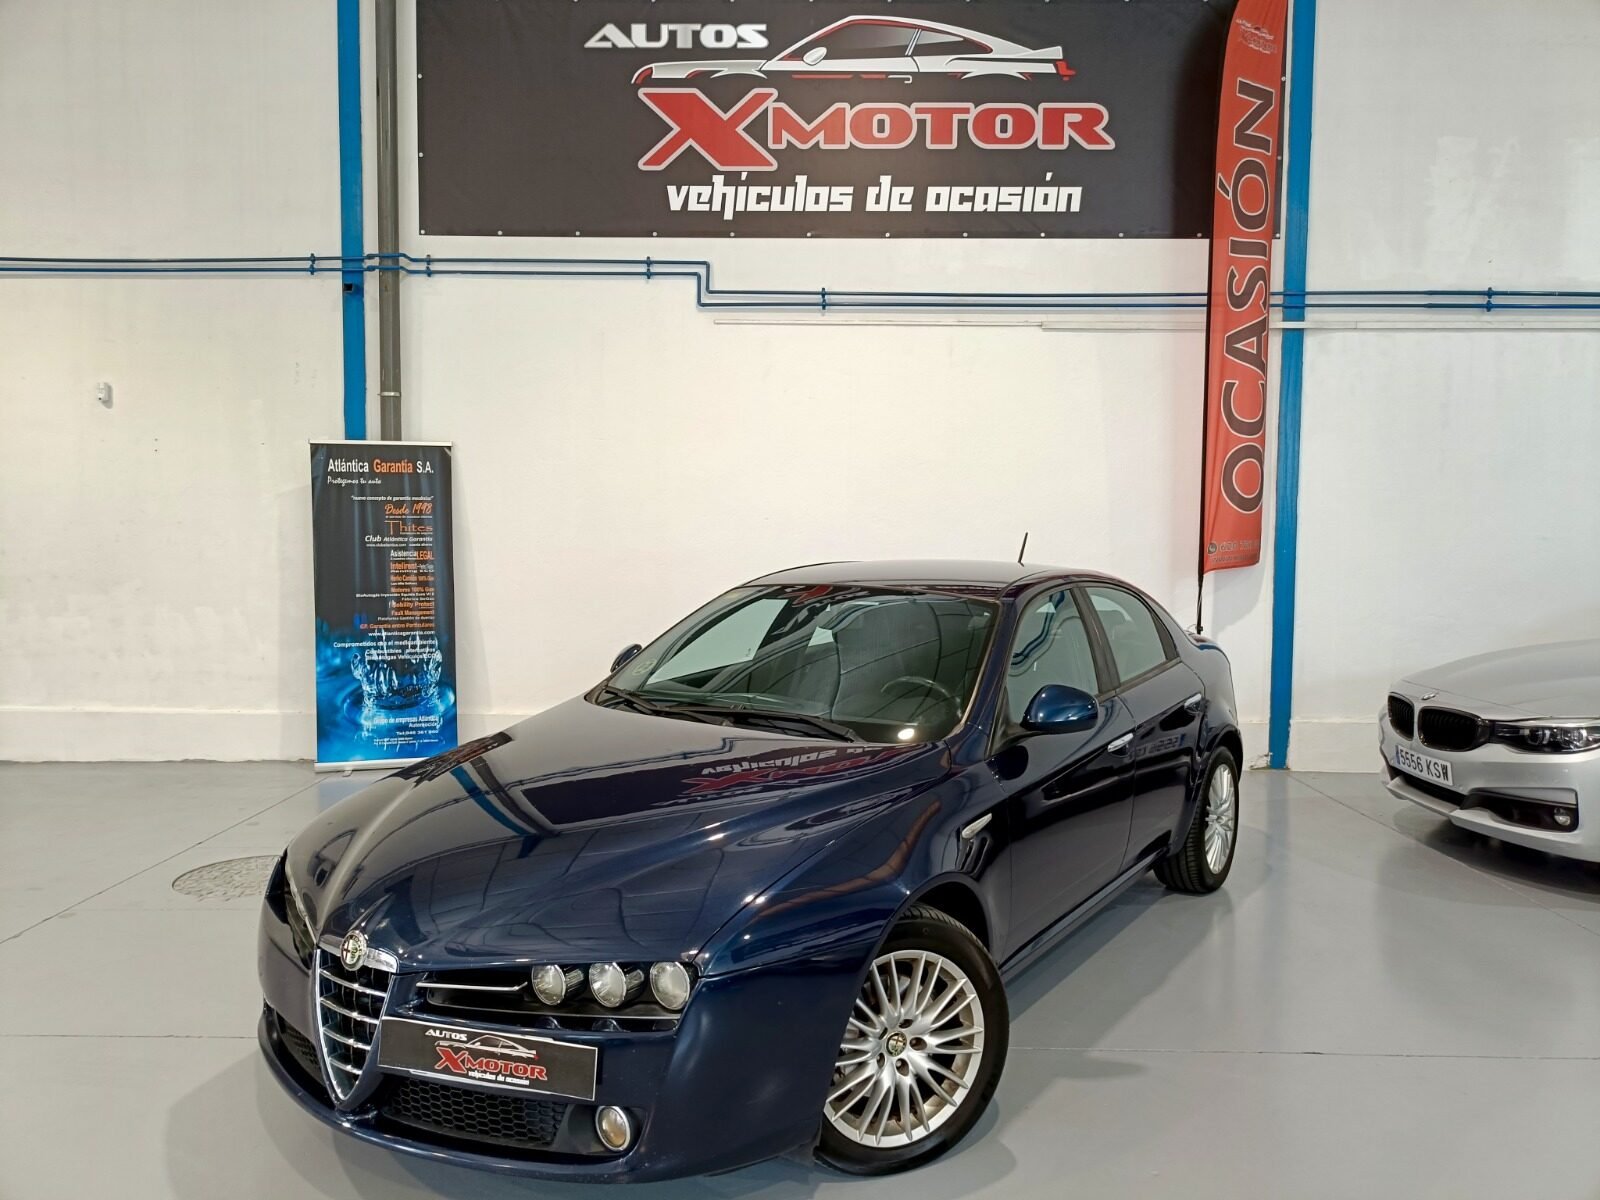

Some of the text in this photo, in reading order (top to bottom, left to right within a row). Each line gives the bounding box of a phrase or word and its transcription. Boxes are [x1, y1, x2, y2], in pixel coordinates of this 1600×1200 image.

[584, 23, 769, 50] AUTOS
[667, 171, 1083, 221] vehículos de ocasión
[1216, 77, 1275, 514] OCASIÓN
[328, 458, 369, 472] Atlántica
[416, 461, 434, 474] S.A.
[385, 502, 432, 514] Desde 1998
[1400, 748, 1449, 782] 5556 KSW
[425, 1029, 467, 1041] AUTOS
